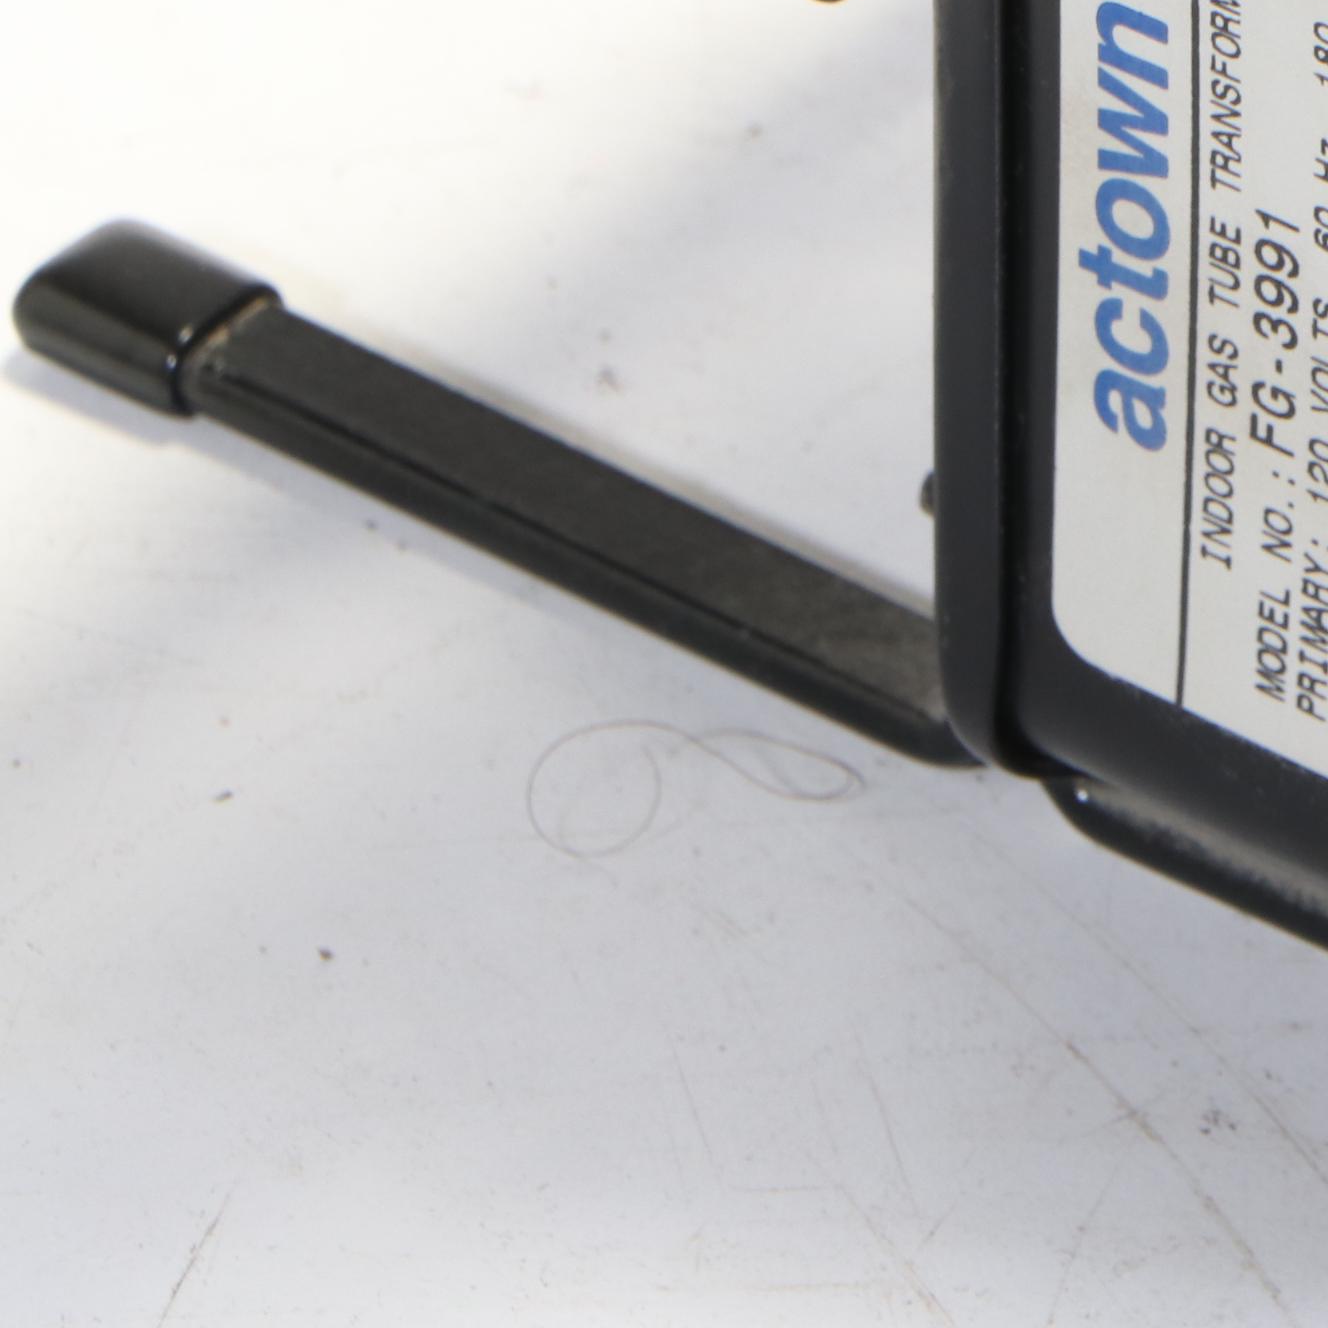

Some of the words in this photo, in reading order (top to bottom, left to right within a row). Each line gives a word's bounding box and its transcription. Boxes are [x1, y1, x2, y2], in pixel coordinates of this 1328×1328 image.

[1078, 2, 1170, 451] actown
[1208, 217, 1241, 307] TUBE
[1207, 334, 1238, 407] GAS
[1250, 210, 1299, 457] FG-3991
[1201, 428, 1236, 569] INDOOR
[1261, 471, 1295, 562] NO.:
[1256, 590, 1290, 701] MODEL
